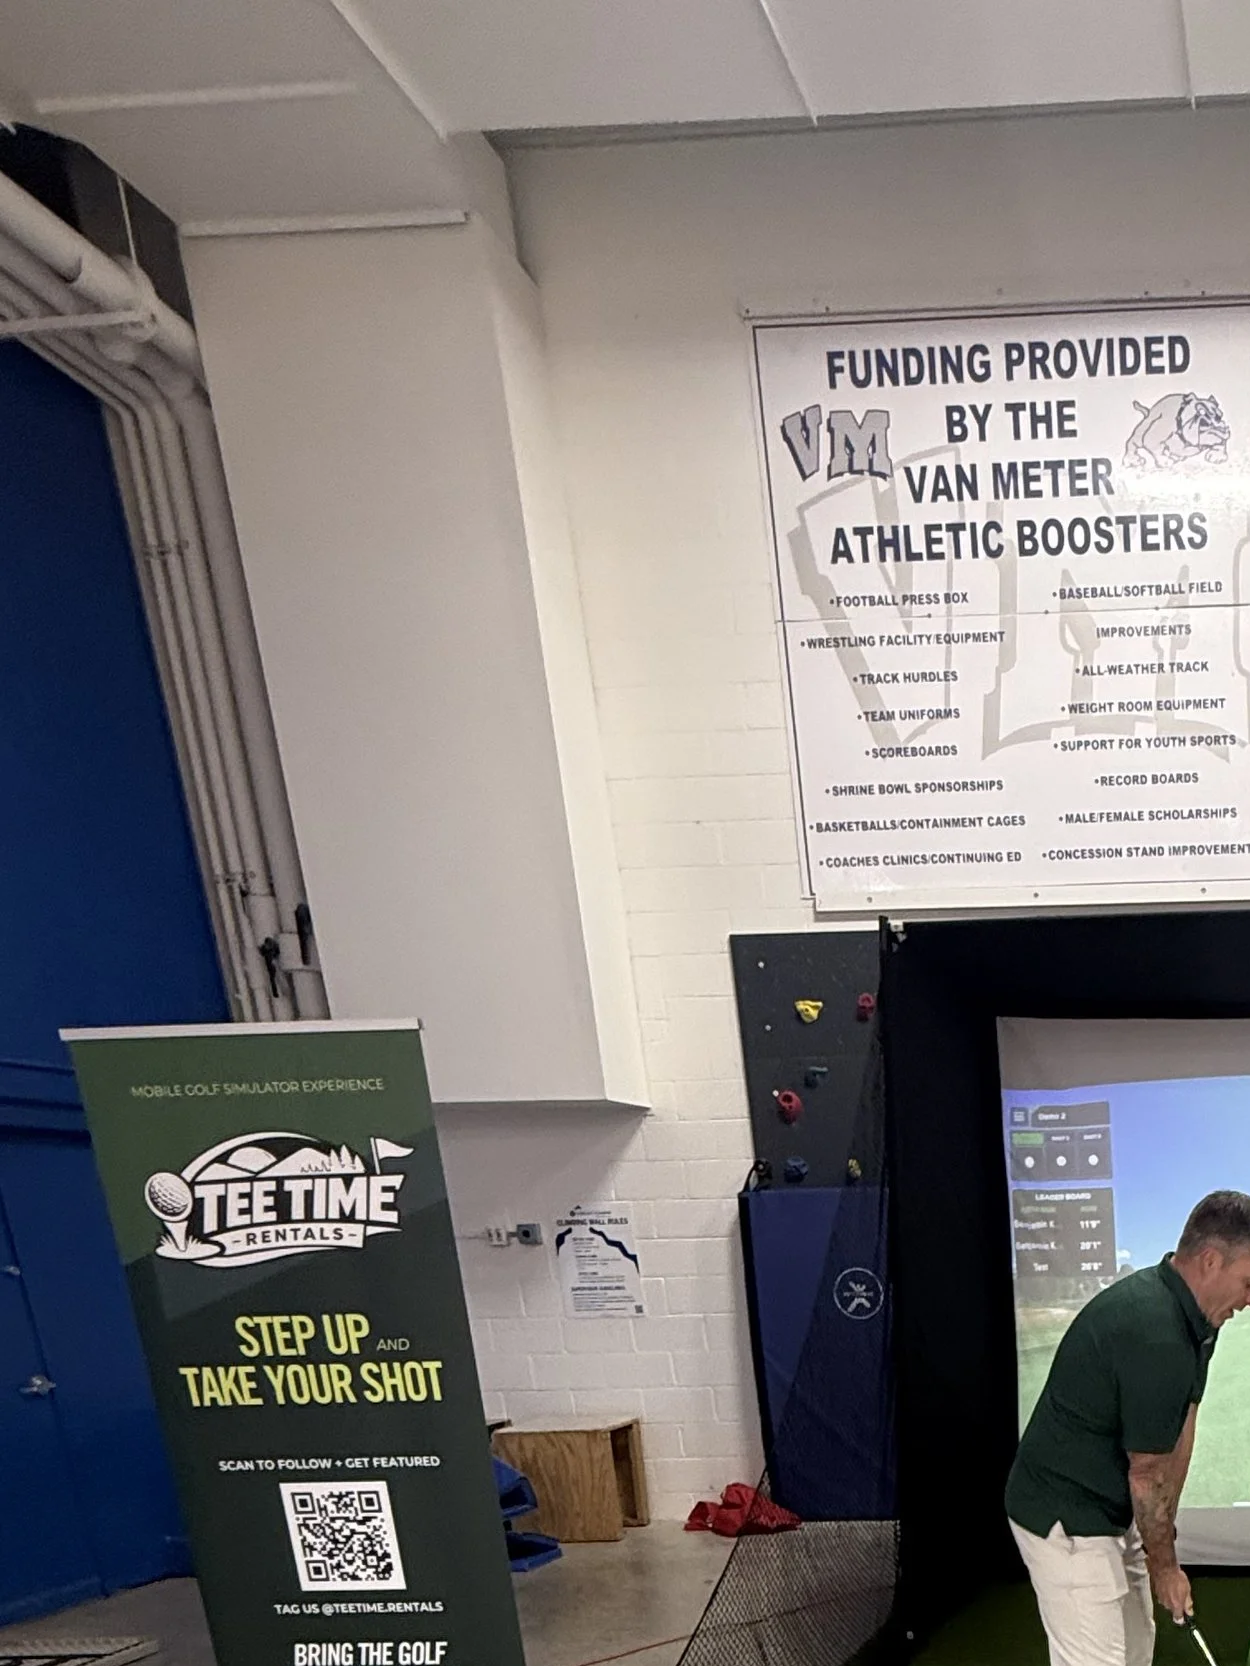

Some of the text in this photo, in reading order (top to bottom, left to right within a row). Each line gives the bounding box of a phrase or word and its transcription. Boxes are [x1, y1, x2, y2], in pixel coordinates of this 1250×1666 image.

[826, 335, 1191, 390] FUNDING PROVIDED
[945, 400, 1078, 443] BY THE
[904, 457, 1115, 504] VAN METER
[830, 512, 1209, 565] ATHLETIC BOOSTERS
[1059, 581, 1223, 600] BASEBALL/SOFTBALL FIELD
[836, 592, 969, 608] FOOTBALL PRESS BOX
[807, 631, 1005, 649] WRESTLING FACILITY/EQUIPMENT
[1096, 624, 1192, 638] IMPROVEMENTS
[1082, 661, 1209, 675] ALL-WEATHER TRACK
[860, 670, 958, 685] TRACK HURDLES
[862, 707, 960, 722] TEAM UNIFORMS
[1068, 697, 1226, 715] WEIGHT ROOM EQUIPMENT
[871, 744, 958, 758] SCOREBOARDS
[1060, 734, 1237, 751] SUPPORT FOR YOUTH SPORTS
[832, 779, 1003, 797] SHRINE BOWL SPONSORSHIPS
[1100, 772, 1199, 787] RECORD BOARDS
[816, 815, 1026, 834] BASKETBALLS/CONTAINMENT CAGES
[1065, 807, 1237, 824] MALE/FEMALE SCHOLARSHIPS
[826, 850, 1021, 868] COACHES CLINICS/CONTINUING ED
[1048, 846, 1123, 861] CONCESSION
[1126, 845, 1164, 858] STAND
[131, 1079, 384, 1098] MOBILE GOLF SIMULATOR EXPERIENCE
[194, 1174, 405, 1236] TEE TIME
[246, 1228, 344, 1246] RENTALS
[235, 1314, 409, 1357] STEP UP AND
[179, 1361, 442, 1407] TAKE YOUR SHOT
[219, 1460, 255, 1472] SCAN
[256, 1460, 275, 1470] TO
[278, 1458, 332, 1469] FOLLOW
[345, 1458, 371, 1468] GET
[373, 1456, 440, 1467] FEATURED
[274, 1601, 444, 1616] TAG US @TEETIME.RENTALS
[294, 1641, 448, 1666] BRING THE GOLF
